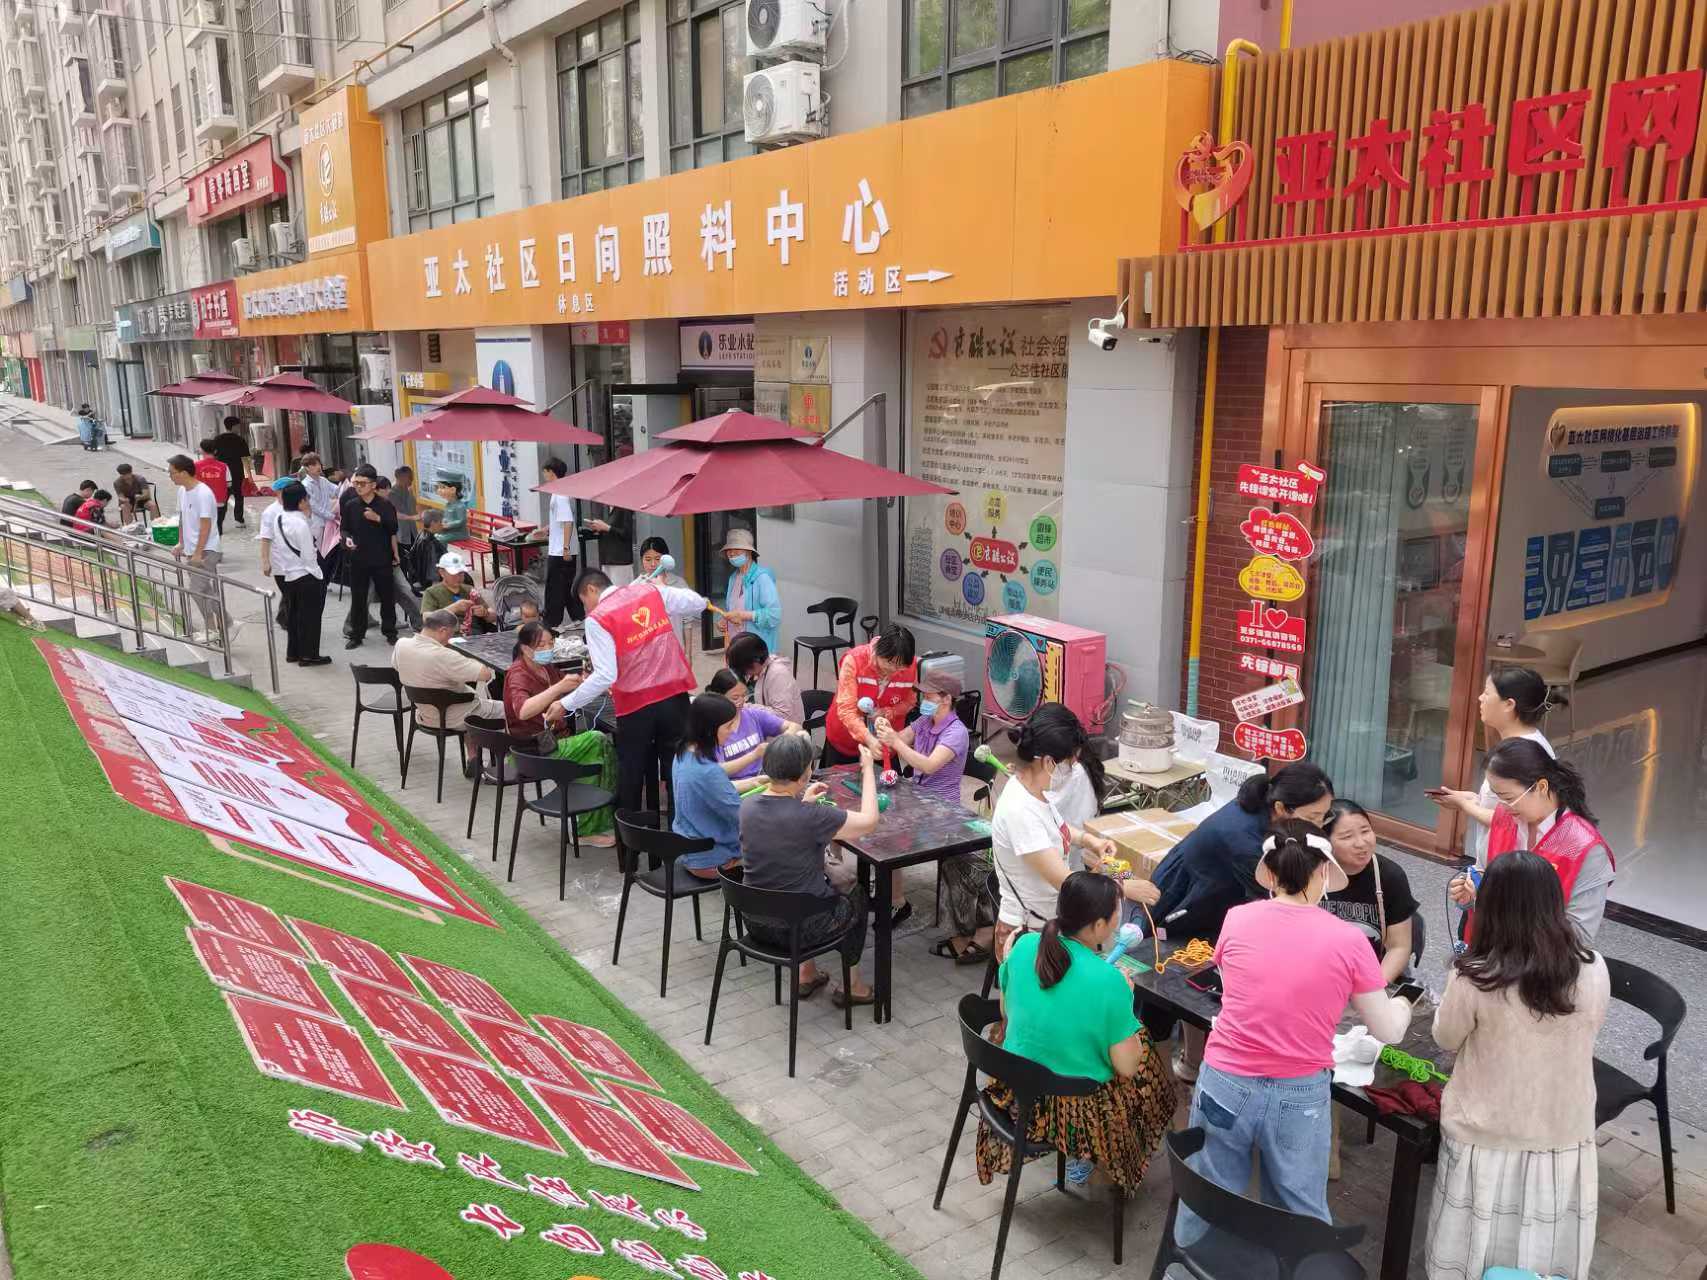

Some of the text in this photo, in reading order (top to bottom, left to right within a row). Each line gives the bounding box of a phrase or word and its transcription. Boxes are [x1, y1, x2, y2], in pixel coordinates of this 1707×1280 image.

[1273, 69, 1705, 204] 亚太社区网
[423, 178, 892, 298] 亚太社区日间照料中心
[557, 293, 595, 315] 休息区
[832, 265, 903, 298] 活动区
